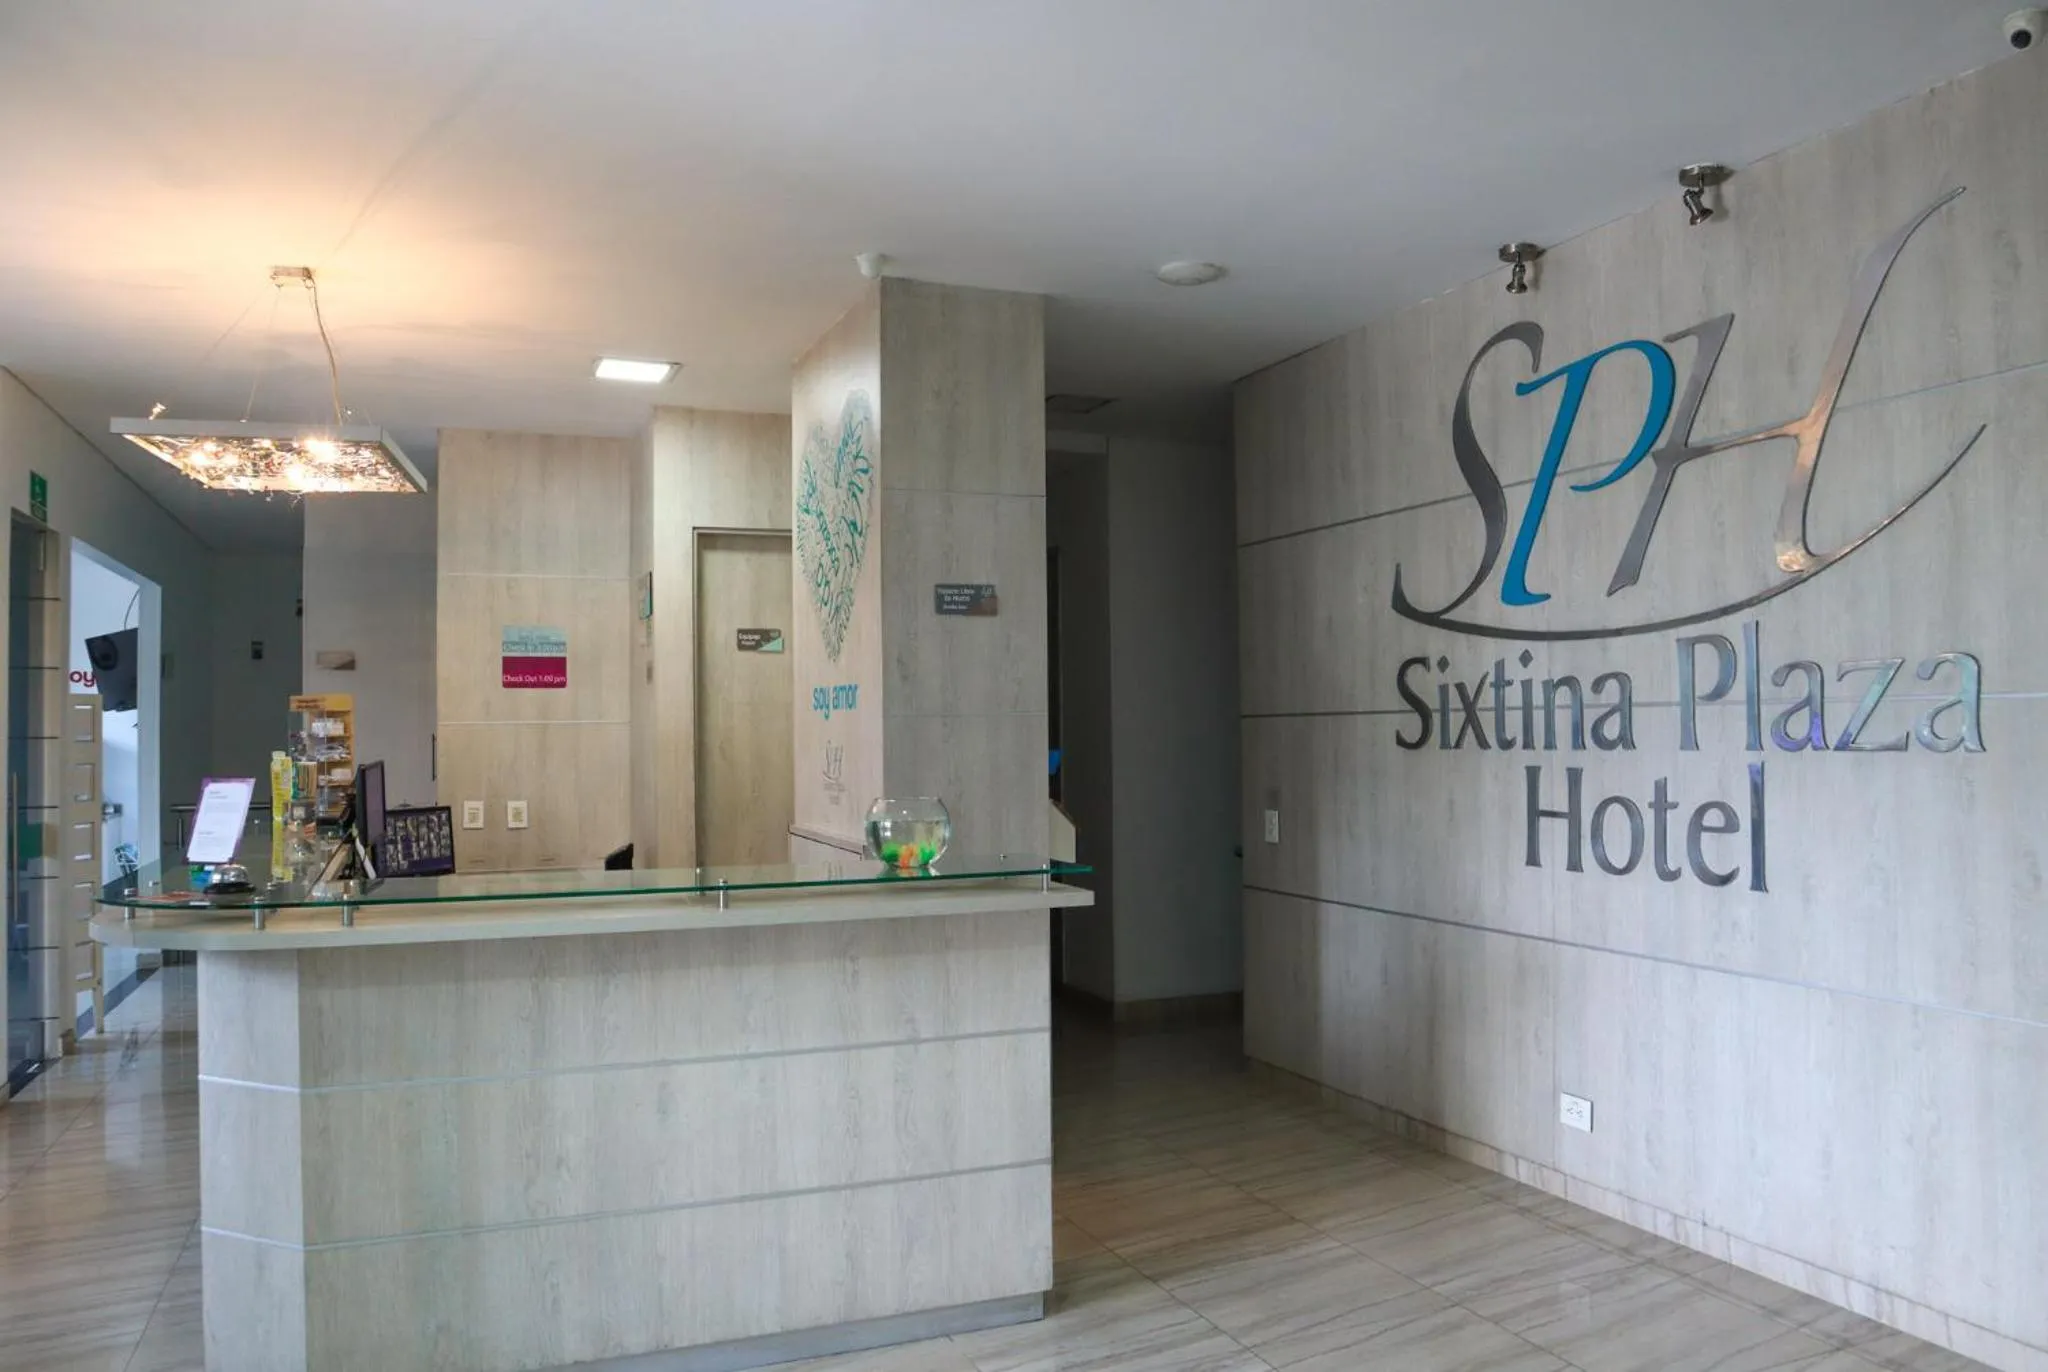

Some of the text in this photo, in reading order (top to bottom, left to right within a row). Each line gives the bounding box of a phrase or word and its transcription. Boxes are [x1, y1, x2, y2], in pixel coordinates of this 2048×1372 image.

[813, 684, 858, 720] soy amor
[1395, 619, 1987, 754] Sixtina Plaza
[1525, 760, 1769, 894] Hotel
